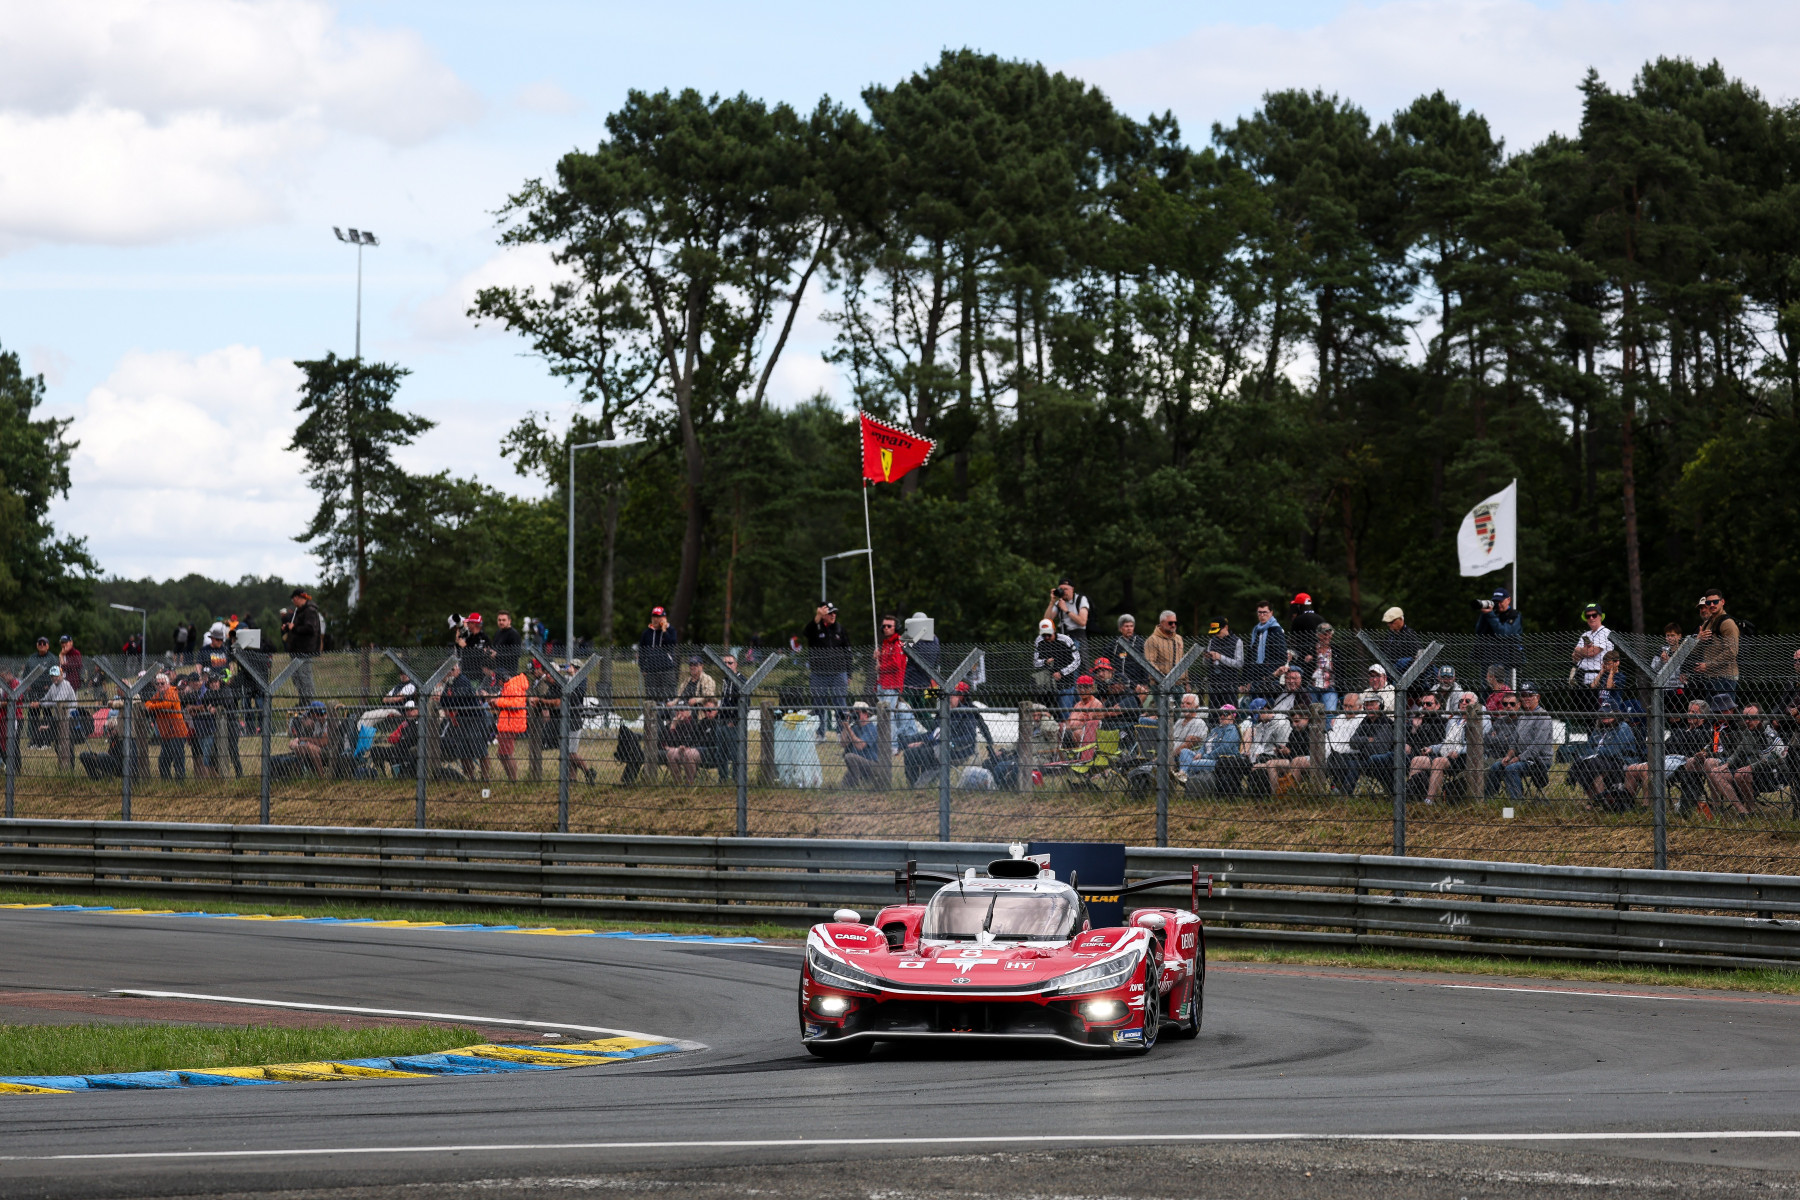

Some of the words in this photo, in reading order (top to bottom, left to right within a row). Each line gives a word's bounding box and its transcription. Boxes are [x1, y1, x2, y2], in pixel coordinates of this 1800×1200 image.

[835, 933, 867, 941] CASIO
[1181, 932, 1195, 950] DENSO
[959, 949, 983, 958] 8
[1005, 961, 1034, 969] HY
